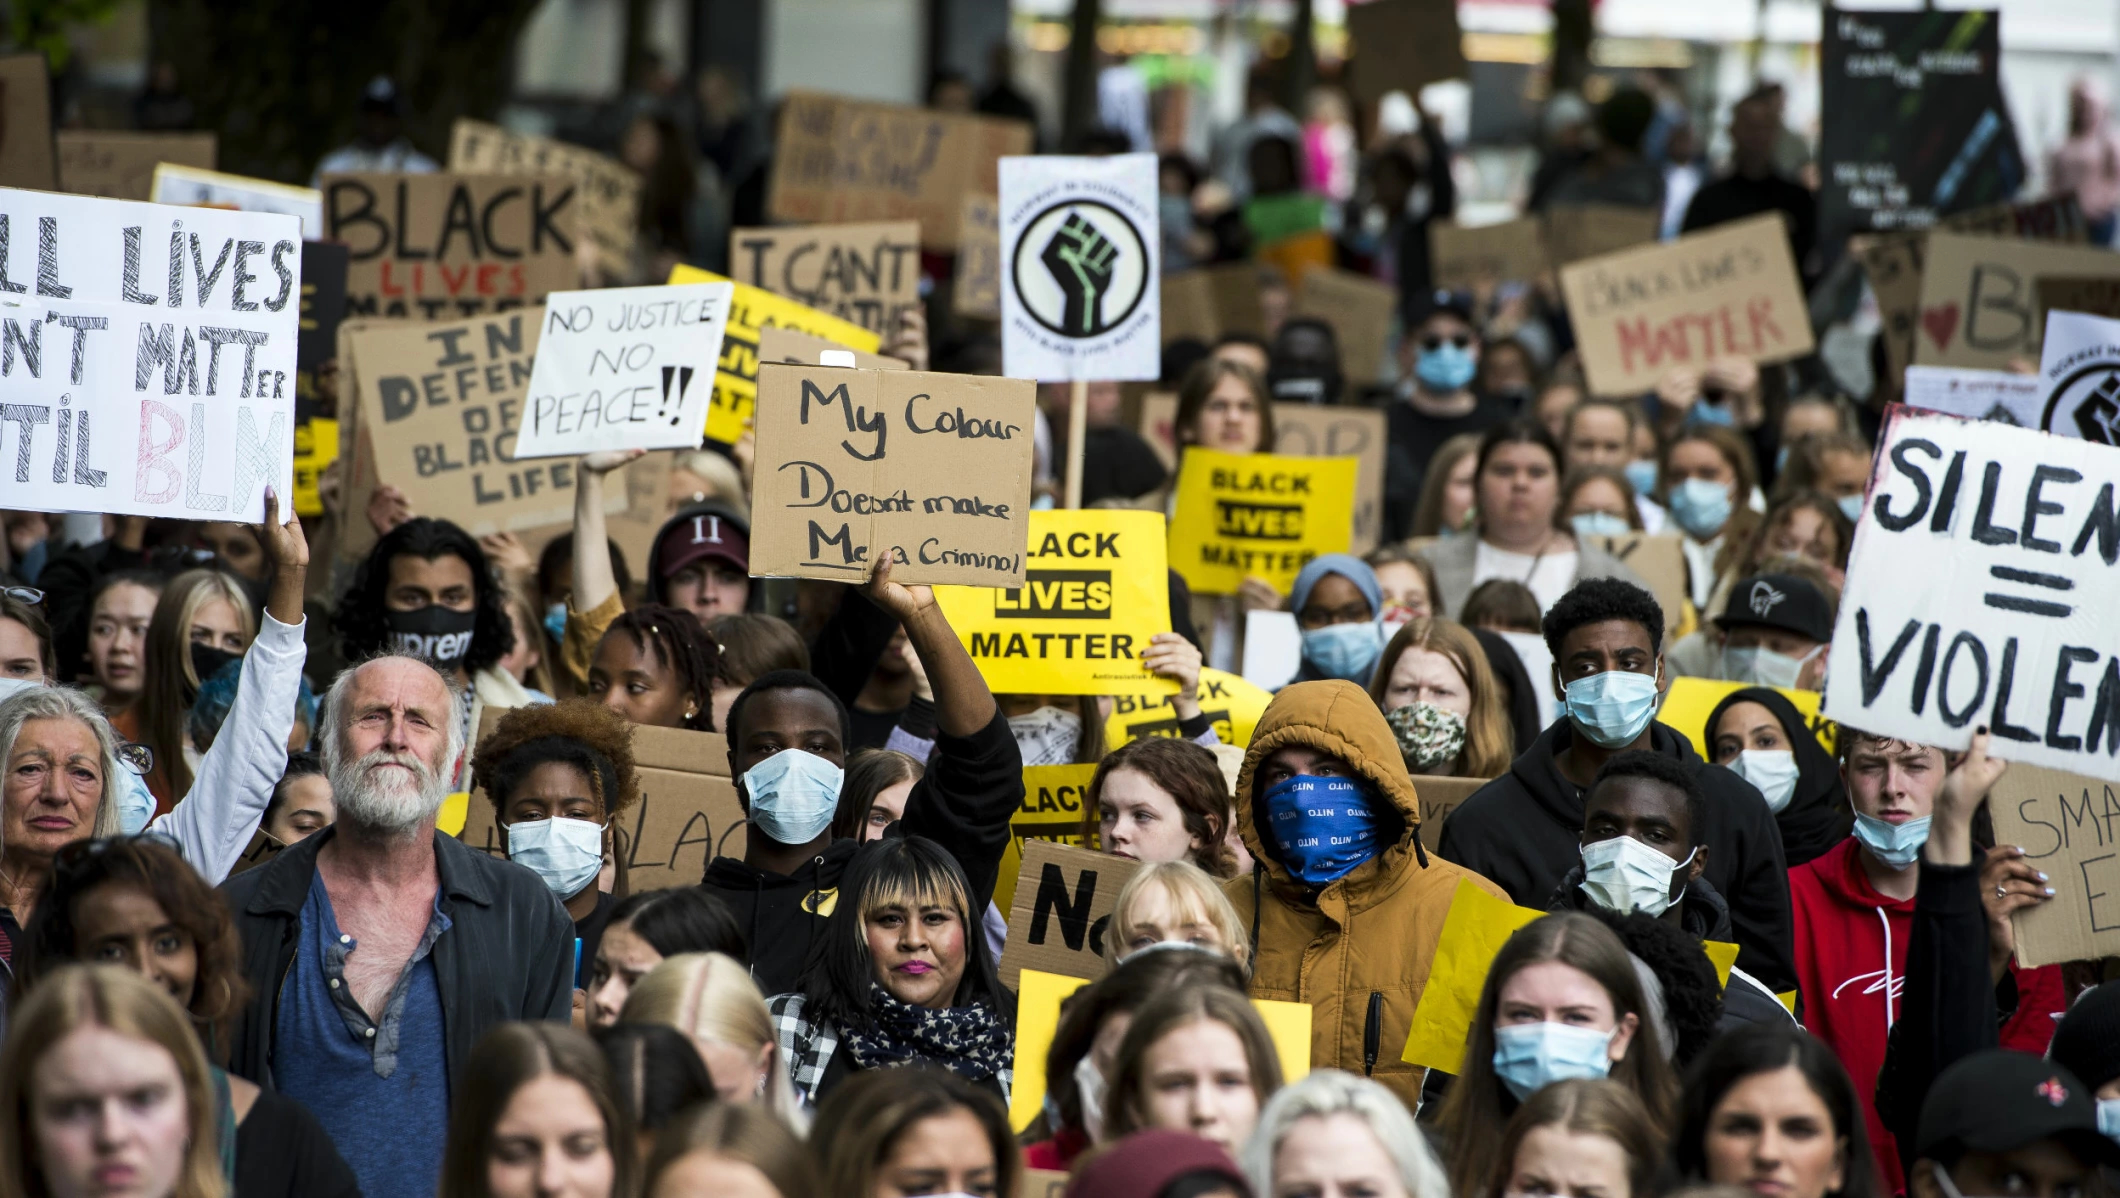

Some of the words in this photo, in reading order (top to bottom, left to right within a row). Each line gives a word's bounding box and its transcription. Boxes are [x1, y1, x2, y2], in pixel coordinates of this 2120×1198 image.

[327, 179, 578, 263] BLACK
[0, 213, 73, 299] LL
[741, 238, 774, 289] I
[379, 259, 529, 297] LIVES
[549, 304, 594, 335] NO
[608, 298, 718, 333] JUSTICE
[1615, 296, 1787, 376] MATTER
[2, 309, 109, 386] N'T
[427, 315, 524, 369] IN
[589, 342, 656, 377] NO
[377, 355, 536, 425] DEFEN
[461, 402, 519, 434] OF
[801, 378, 888, 461] My
[904, 393, 1022, 440] Colour
[134, 399, 287, 515] BLM
[412, 431, 520, 479] BLAC
[472, 462, 574, 505] LIFE
[1210, 467, 1313, 495] BLACK
[1873, 437, 2120, 567] SILEN
[922, 494, 1011, 521] make
[1218, 507, 1302, 536] LIVES
[808, 518, 869, 566] Me
[918, 536, 1020, 575] Criminal
[1027, 531, 1122, 559] ACK
[995, 579, 1112, 612] LIVES
[970, 631, 1135, 661] MATTER
[1855, 606, 2120, 760] VIOLEN
[1291, 782, 1315, 793] NITO
[1328, 782, 1354, 791] NITO
[1307, 808, 1335, 817] NITO
[1297, 837, 1319, 848] NITO
[1330, 835, 1352, 846] NITO
